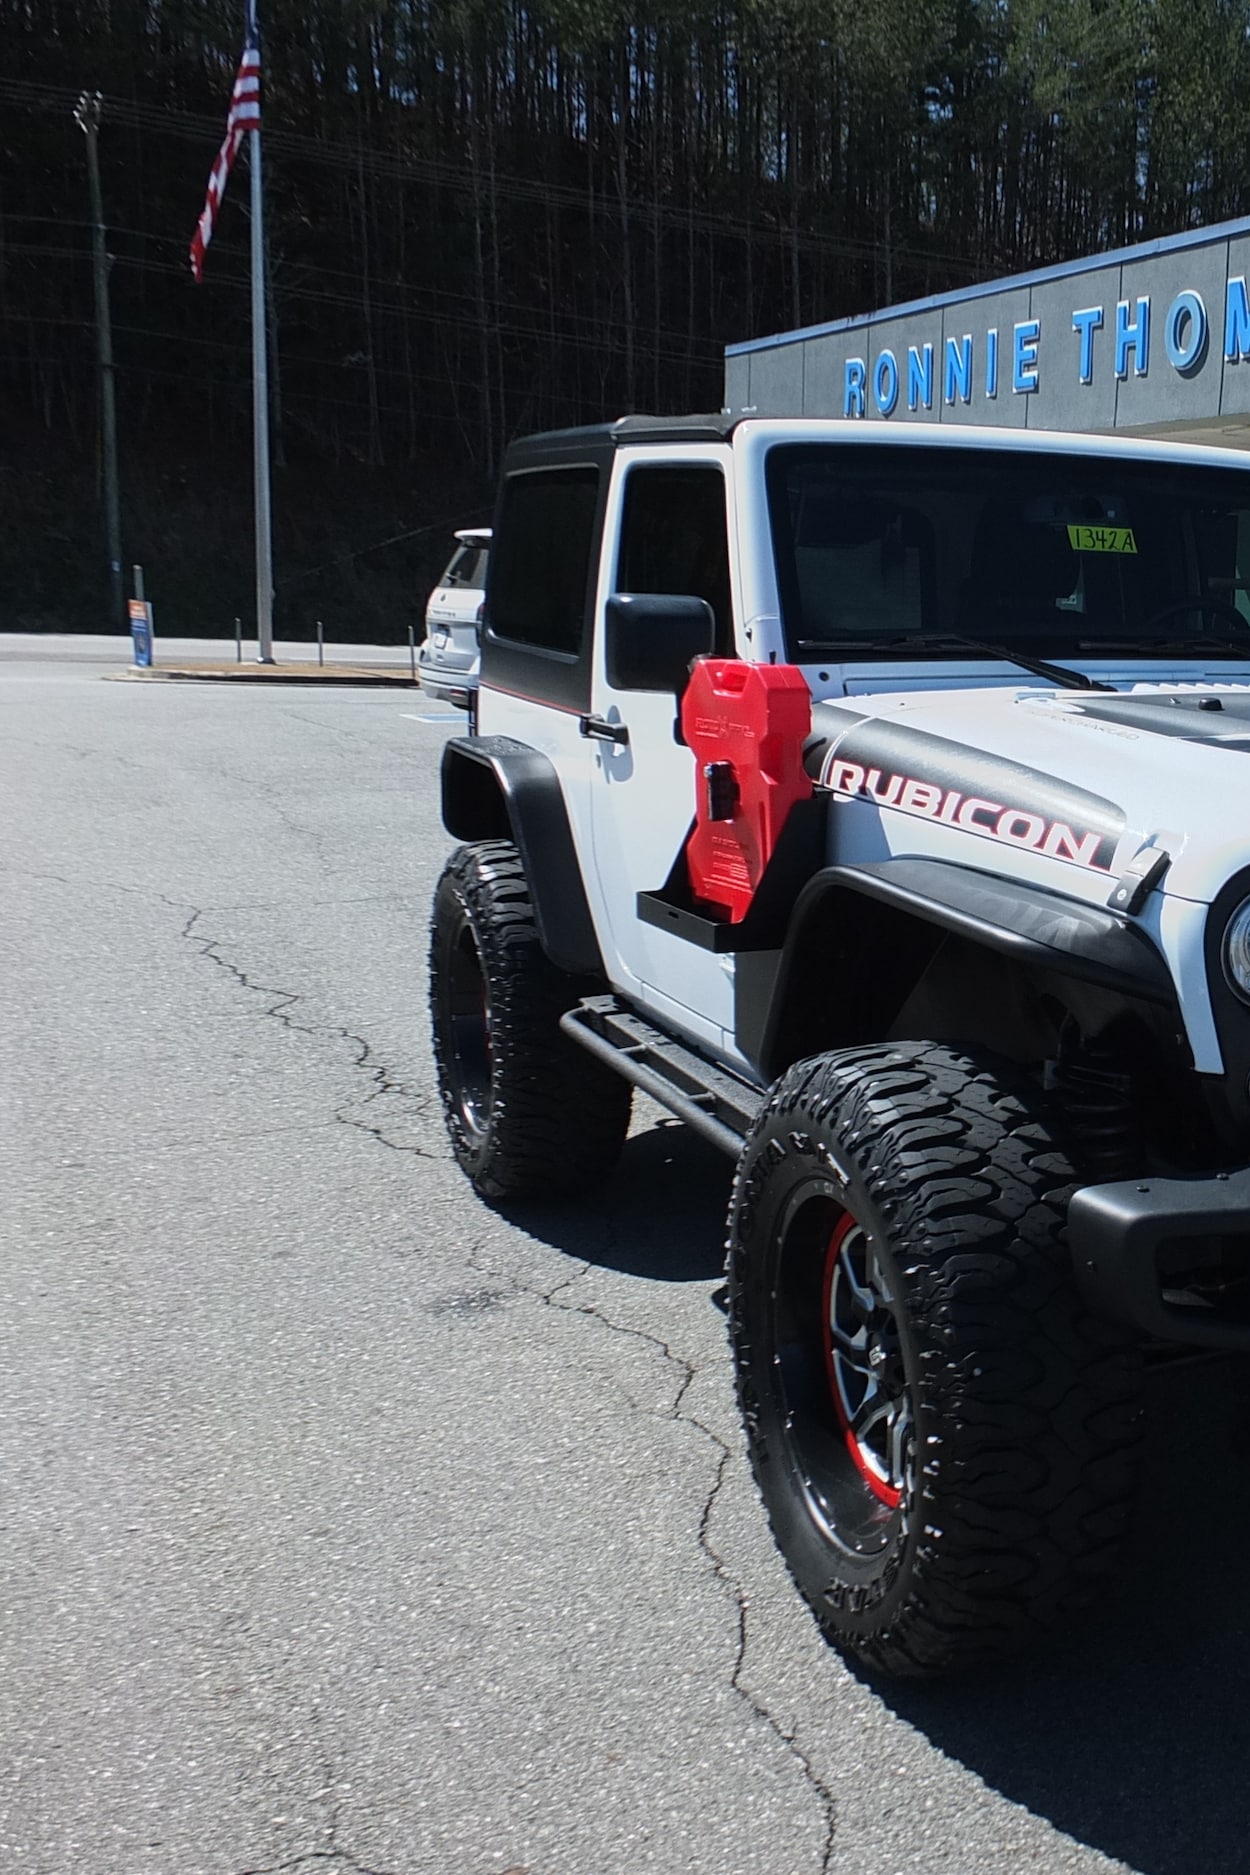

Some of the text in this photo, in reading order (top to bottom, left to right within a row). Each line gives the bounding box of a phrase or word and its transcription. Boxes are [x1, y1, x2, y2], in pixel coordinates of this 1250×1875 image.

[843, 319, 1040, 418] RONNIE
[1075, 528, 1134, 551] 1342A
[827, 759, 1102, 866] RUBICON
